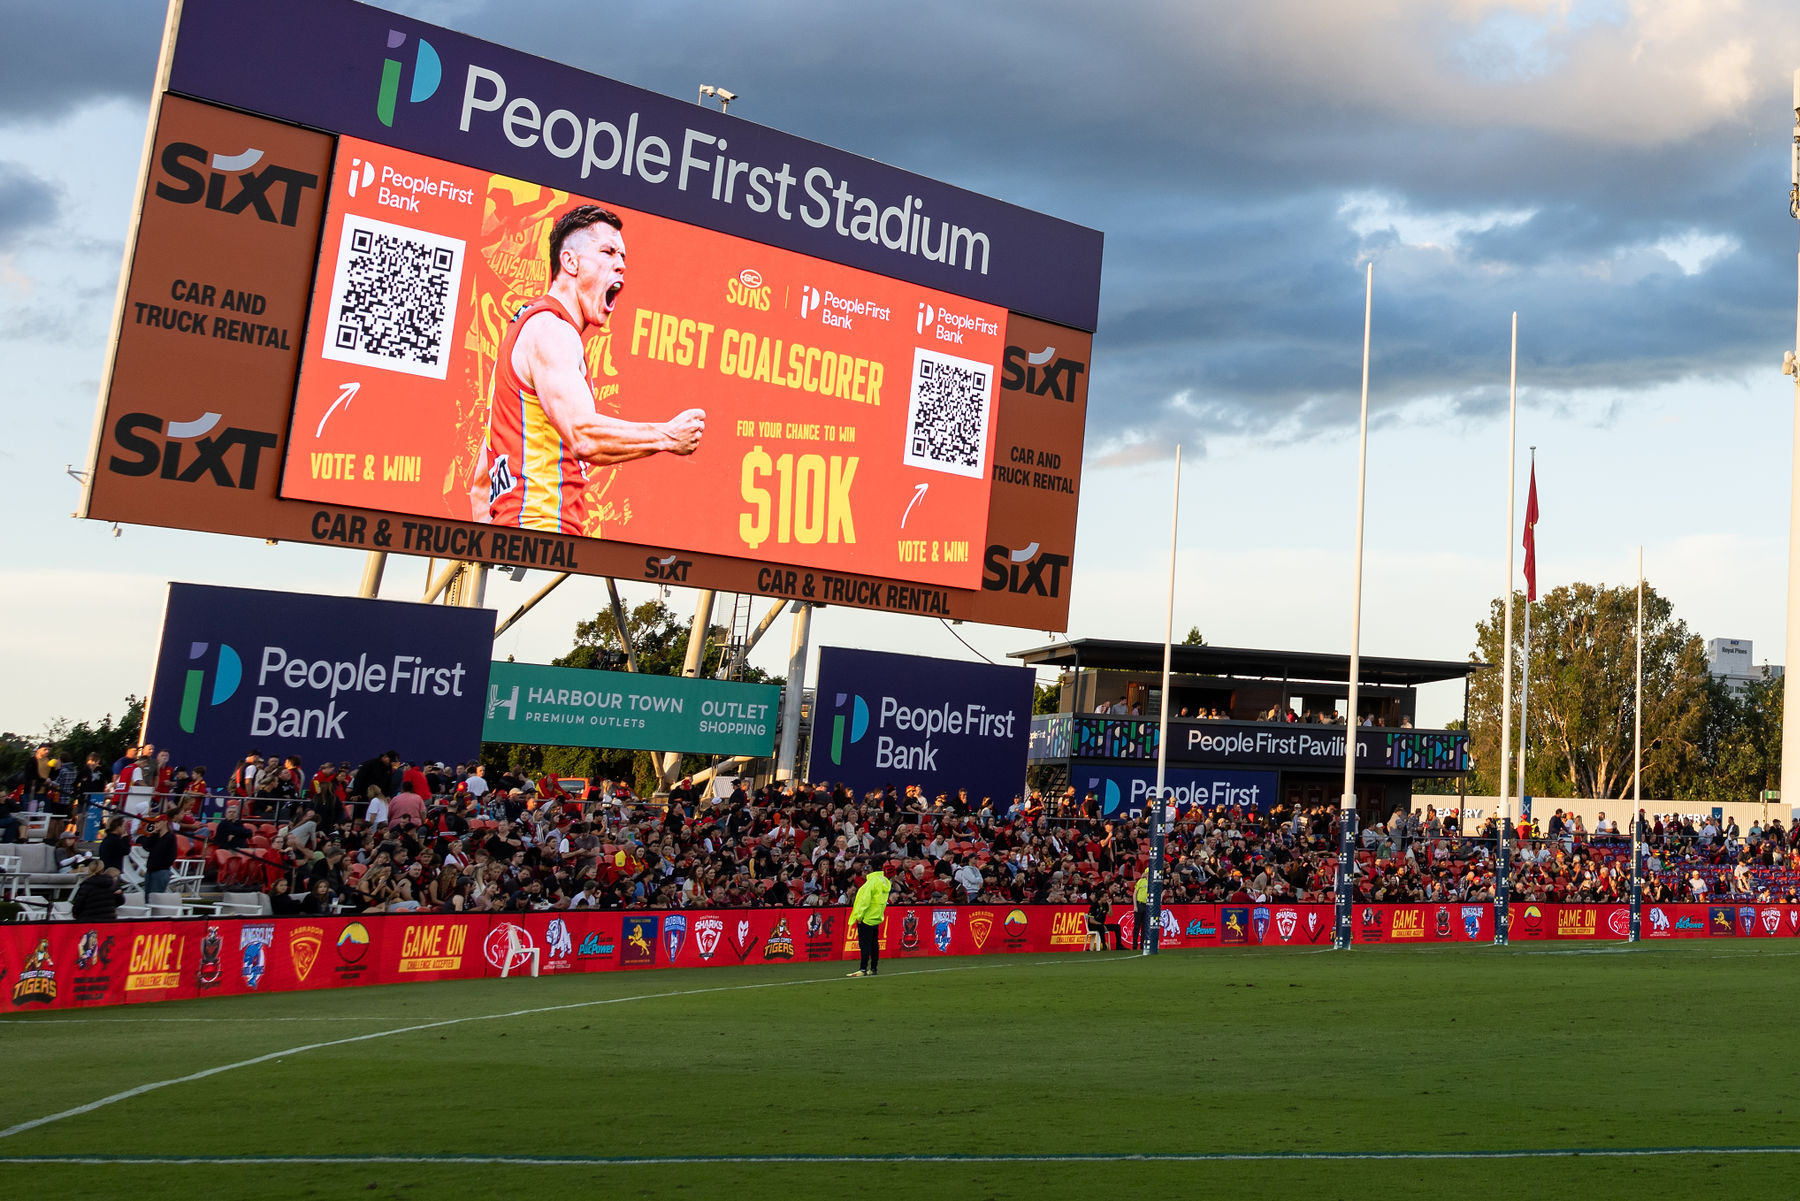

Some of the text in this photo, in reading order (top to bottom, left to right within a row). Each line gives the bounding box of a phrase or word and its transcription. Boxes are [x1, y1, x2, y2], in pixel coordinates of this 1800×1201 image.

[459, 64, 991, 275] People First Stadium
[382, 166, 474, 205] People First
[378, 188, 419, 213] Bank
[171, 279, 267, 316] CAR AND
[726, 278, 771, 311] SUNS
[824, 291, 890, 321] People First
[135, 302, 291, 352] TRUCK RENTAL
[822, 312, 852, 330] Bank
[937, 308, 998, 335] People First
[936, 325, 963, 345] Bank
[631, 308, 714, 368] FIRST
[720, 329, 884, 405] GOALSCORER
[737, 421, 856, 443] FOR YOUR CHANCE TO WIN
[311, 452, 421, 482] VOTE & WIN!
[1010, 447, 1061, 470] CAR AND
[992, 464, 1074, 494] TRUCK RENTAL
[739, 446, 860, 549] $10K
[311, 510, 578, 568] CAR & TRUCK RENTAL
[898, 540, 968, 562] VOTE & WIN!
[757, 568, 950, 614] CAR & TRUCK RENTAL
[257, 646, 465, 699] People First
[528, 687, 683, 714] HARBOUR TOWN
[702, 700, 768, 721] OUTLET
[250, 697, 348, 740] Bank
[526, 712, 645, 729] PREMIUM OUTLETS
[699, 721, 766, 736] SHOPPING
[880, 697, 962, 740] People
[966, 705, 1015, 739] First
[876, 739, 937, 771] Bank
[1188, 729, 1367, 757] People First Pavilin
[1211, 782, 1259, 805] First
[290, 926, 324, 936] LABRADOR
[665, 916, 685, 926] ROBINA
[695, 921, 723, 931] SHARKS
[1052, 912, 1084, 933] GAME
[1393, 910, 1417, 928] GAME
[1558, 910, 1581, 927] GAME
[1585, 909, 1596, 926] ON
[129, 934, 176, 972] GAME
[402, 925, 468, 957] GAME ON
[764, 942, 795, 956] TIGERS
[14, 978, 56, 999] TIGERS
